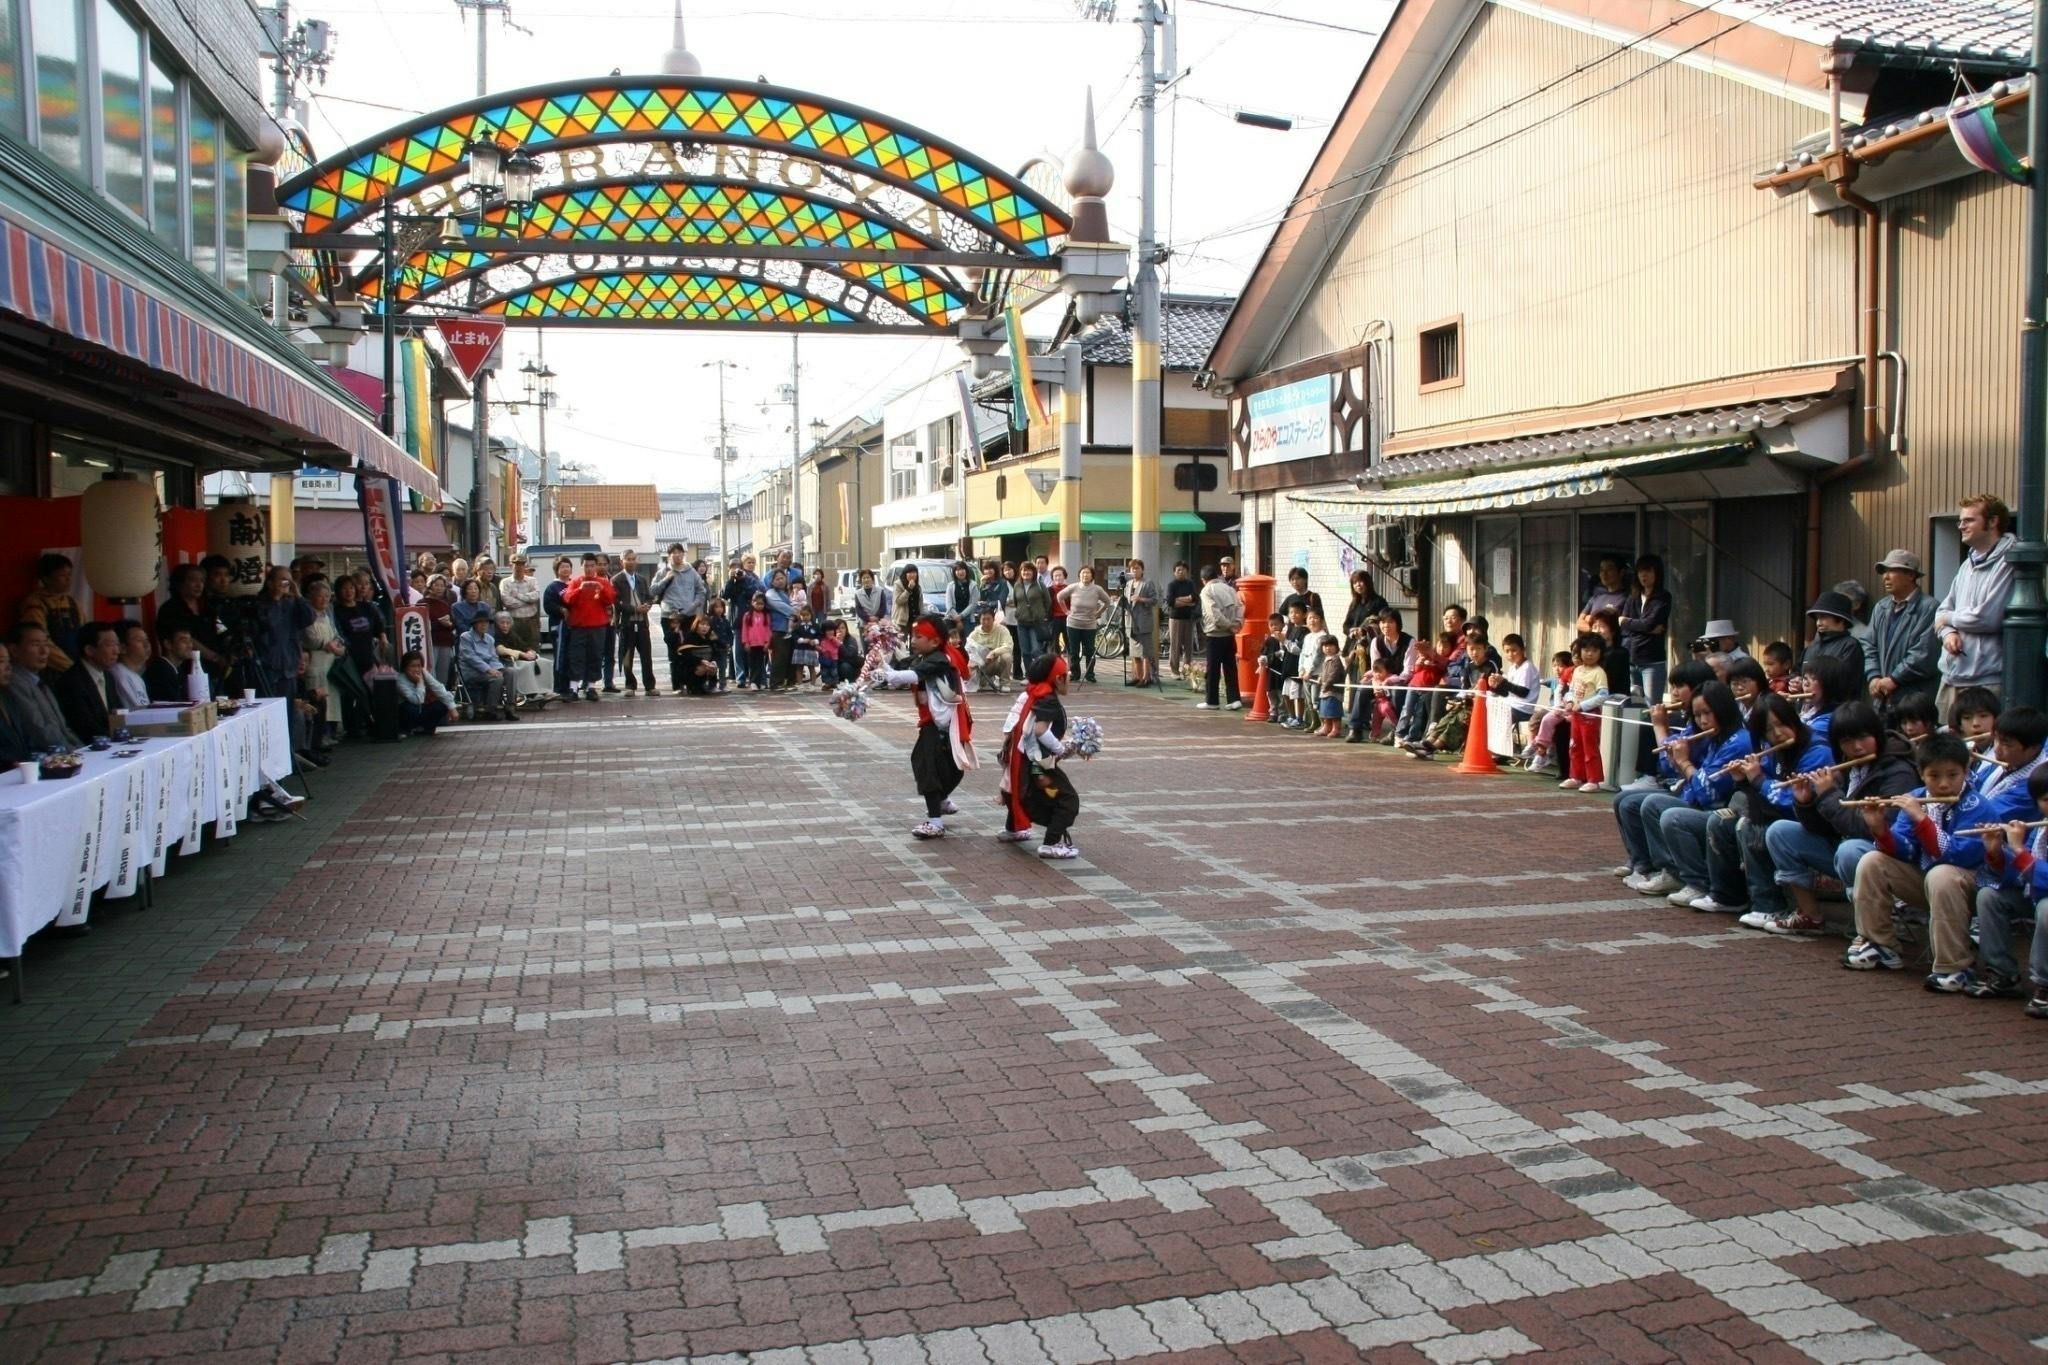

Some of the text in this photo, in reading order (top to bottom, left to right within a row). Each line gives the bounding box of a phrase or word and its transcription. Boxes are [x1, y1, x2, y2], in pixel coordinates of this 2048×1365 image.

[408, 140, 943, 241] HRANOYA
[449, 330, 491, 346] 止まれ
[1253, 416, 1326, 453] ひらのやエコステーション
[404, 615, 424, 653] たば
